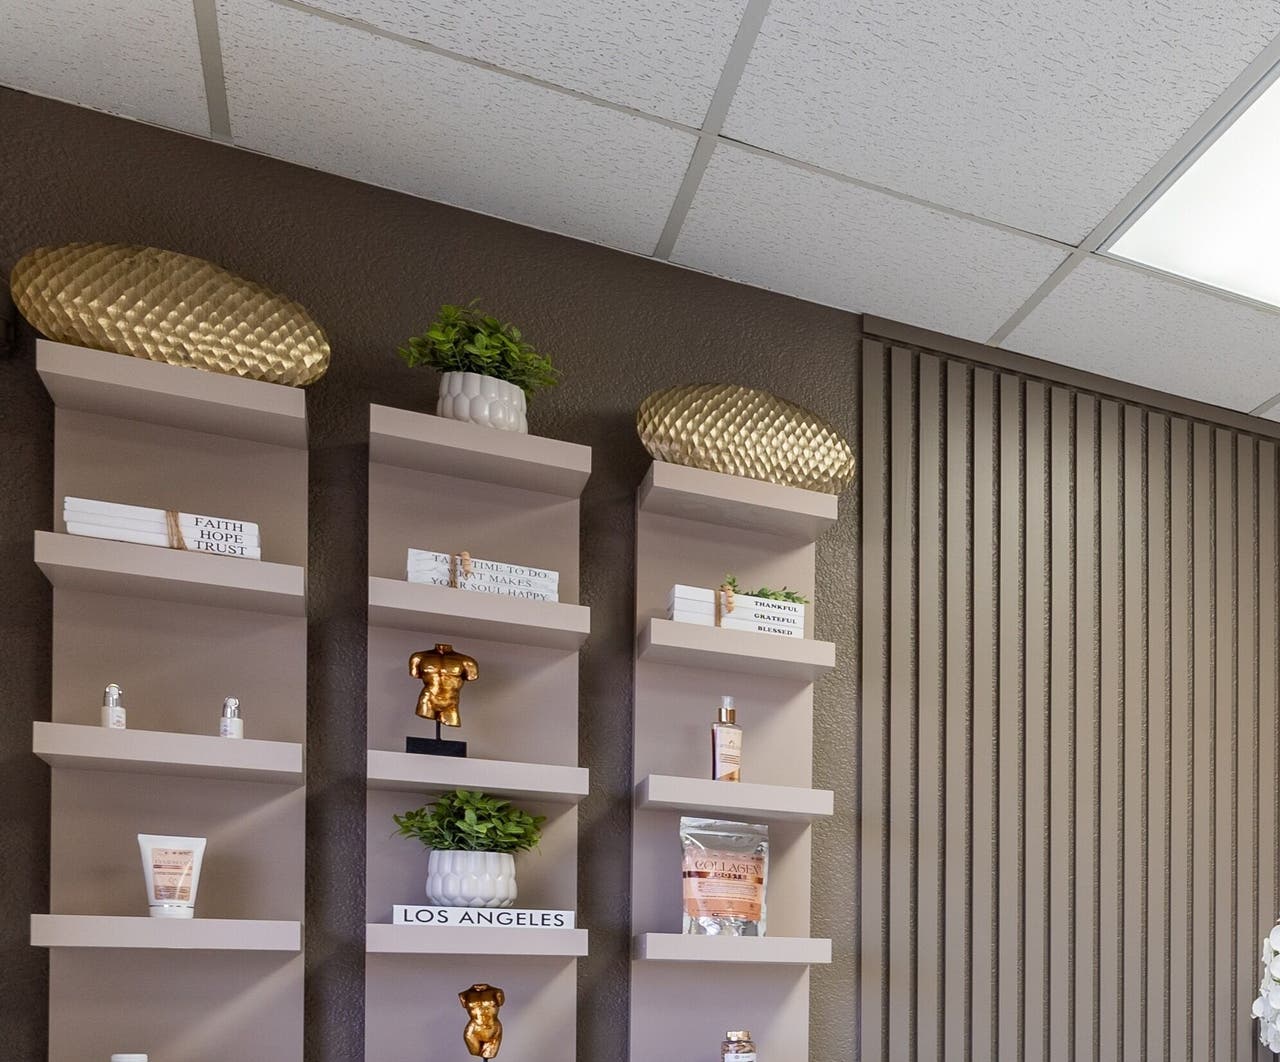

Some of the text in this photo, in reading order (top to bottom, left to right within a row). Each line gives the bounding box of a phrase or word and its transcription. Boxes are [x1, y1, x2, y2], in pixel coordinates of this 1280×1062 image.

[194, 517, 244, 533] FAITH
[200, 529, 243, 545] HOPE
[194, 540, 247, 556] TRUST
[471, 560, 504, 574] TIME
[506, 565, 525, 576] TO
[528, 568, 548, 579] DO
[489, 574, 533, 588] MAKES
[470, 582, 505, 596] SOUL
[507, 588, 550, 601] HAPPY
[754, 600, 799, 612] THANKFUL
[753, 612, 798, 625] GRATEFUL
[757, 625, 793, 636] BLESSED
[403, 908, 565, 927] LOS ANGELES
